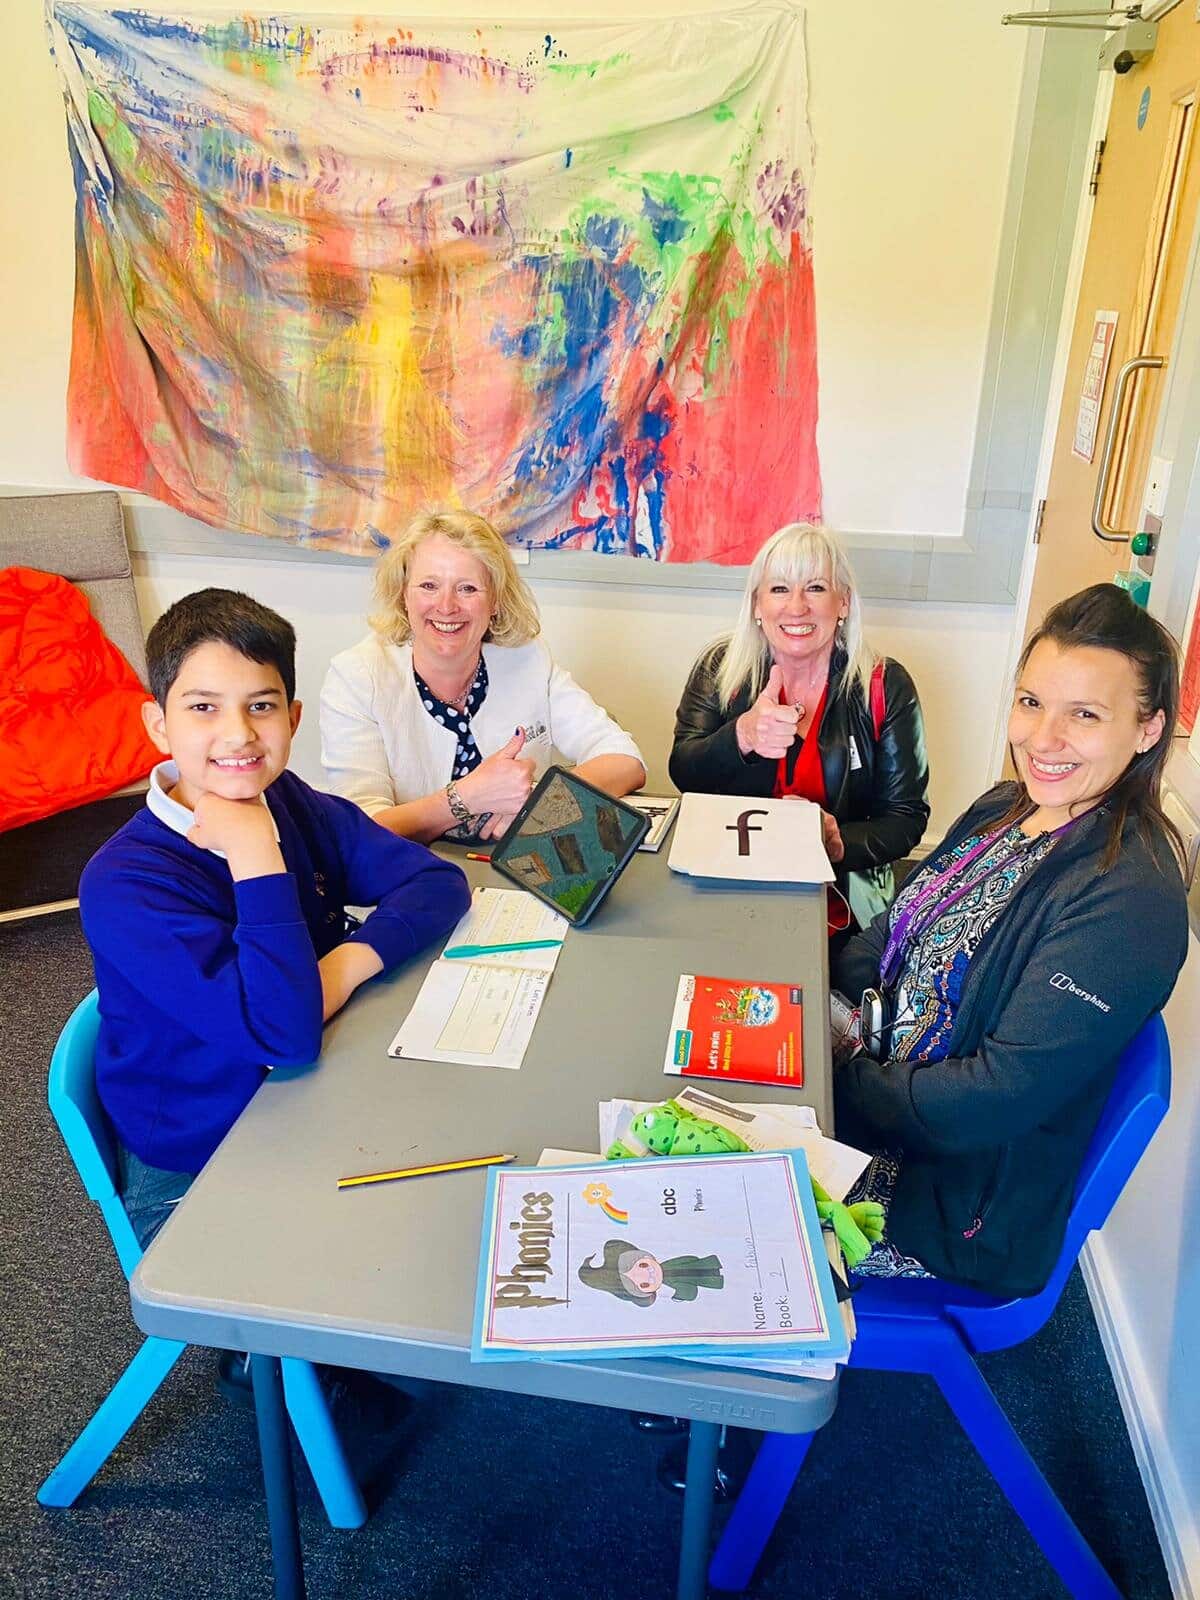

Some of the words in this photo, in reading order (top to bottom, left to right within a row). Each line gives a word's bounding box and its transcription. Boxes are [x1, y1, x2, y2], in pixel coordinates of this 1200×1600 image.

[726, 810, 769, 856] f
[1068, 983, 1111, 1013] berghaus
[711, 1031, 720, 1049] swim
[708, 1048, 719, 1070] Let's
[661, 1188, 677, 1215] abc
[494, 1192, 572, 1309] Phonics
[753, 1291, 767, 1330] Name:
[775, 1295, 793, 1328] Book:
